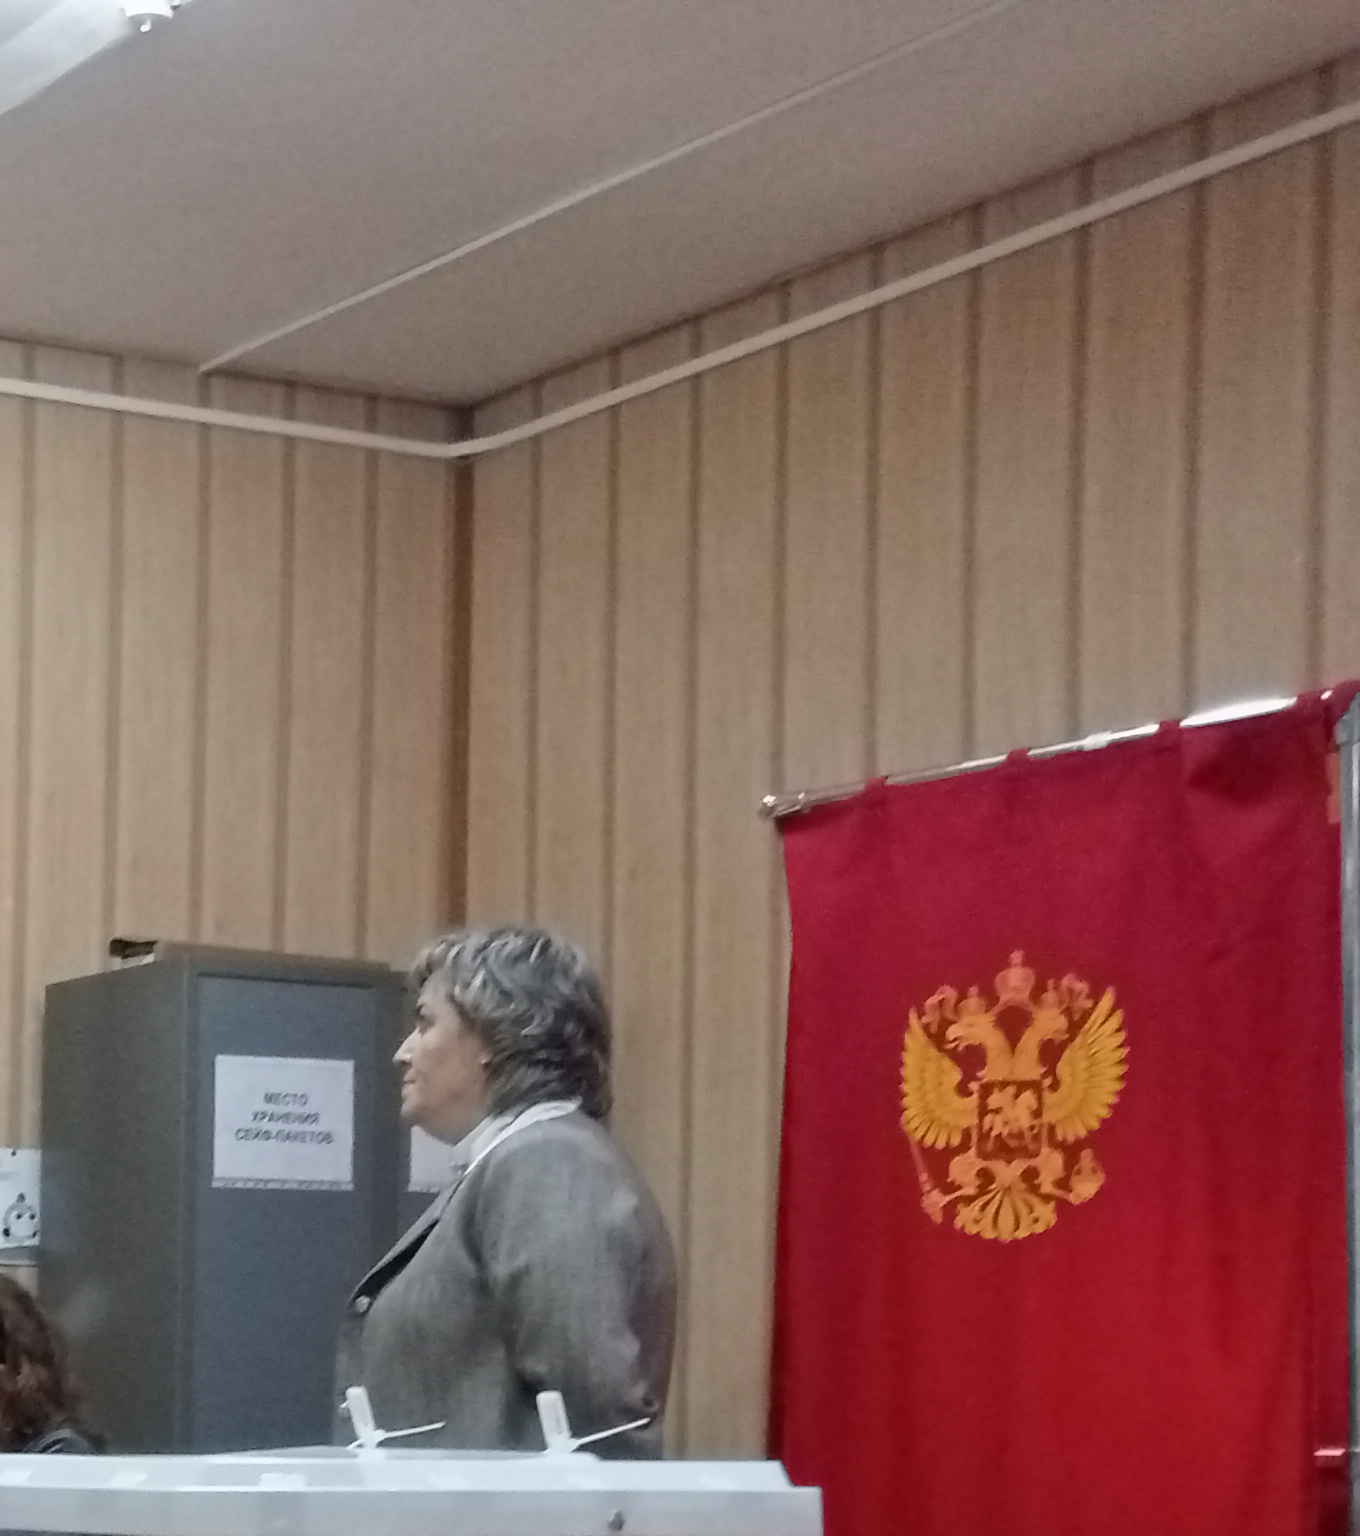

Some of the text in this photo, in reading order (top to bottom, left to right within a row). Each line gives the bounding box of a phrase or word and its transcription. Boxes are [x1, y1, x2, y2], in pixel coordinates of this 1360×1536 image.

[263, 1092, 307, 1107] МЕСТО
[250, 1111, 319, 1126] ХРАНЕНИЯ
[234, 1128, 333, 1144] СЕЙФ-ПАКЕТОВ
